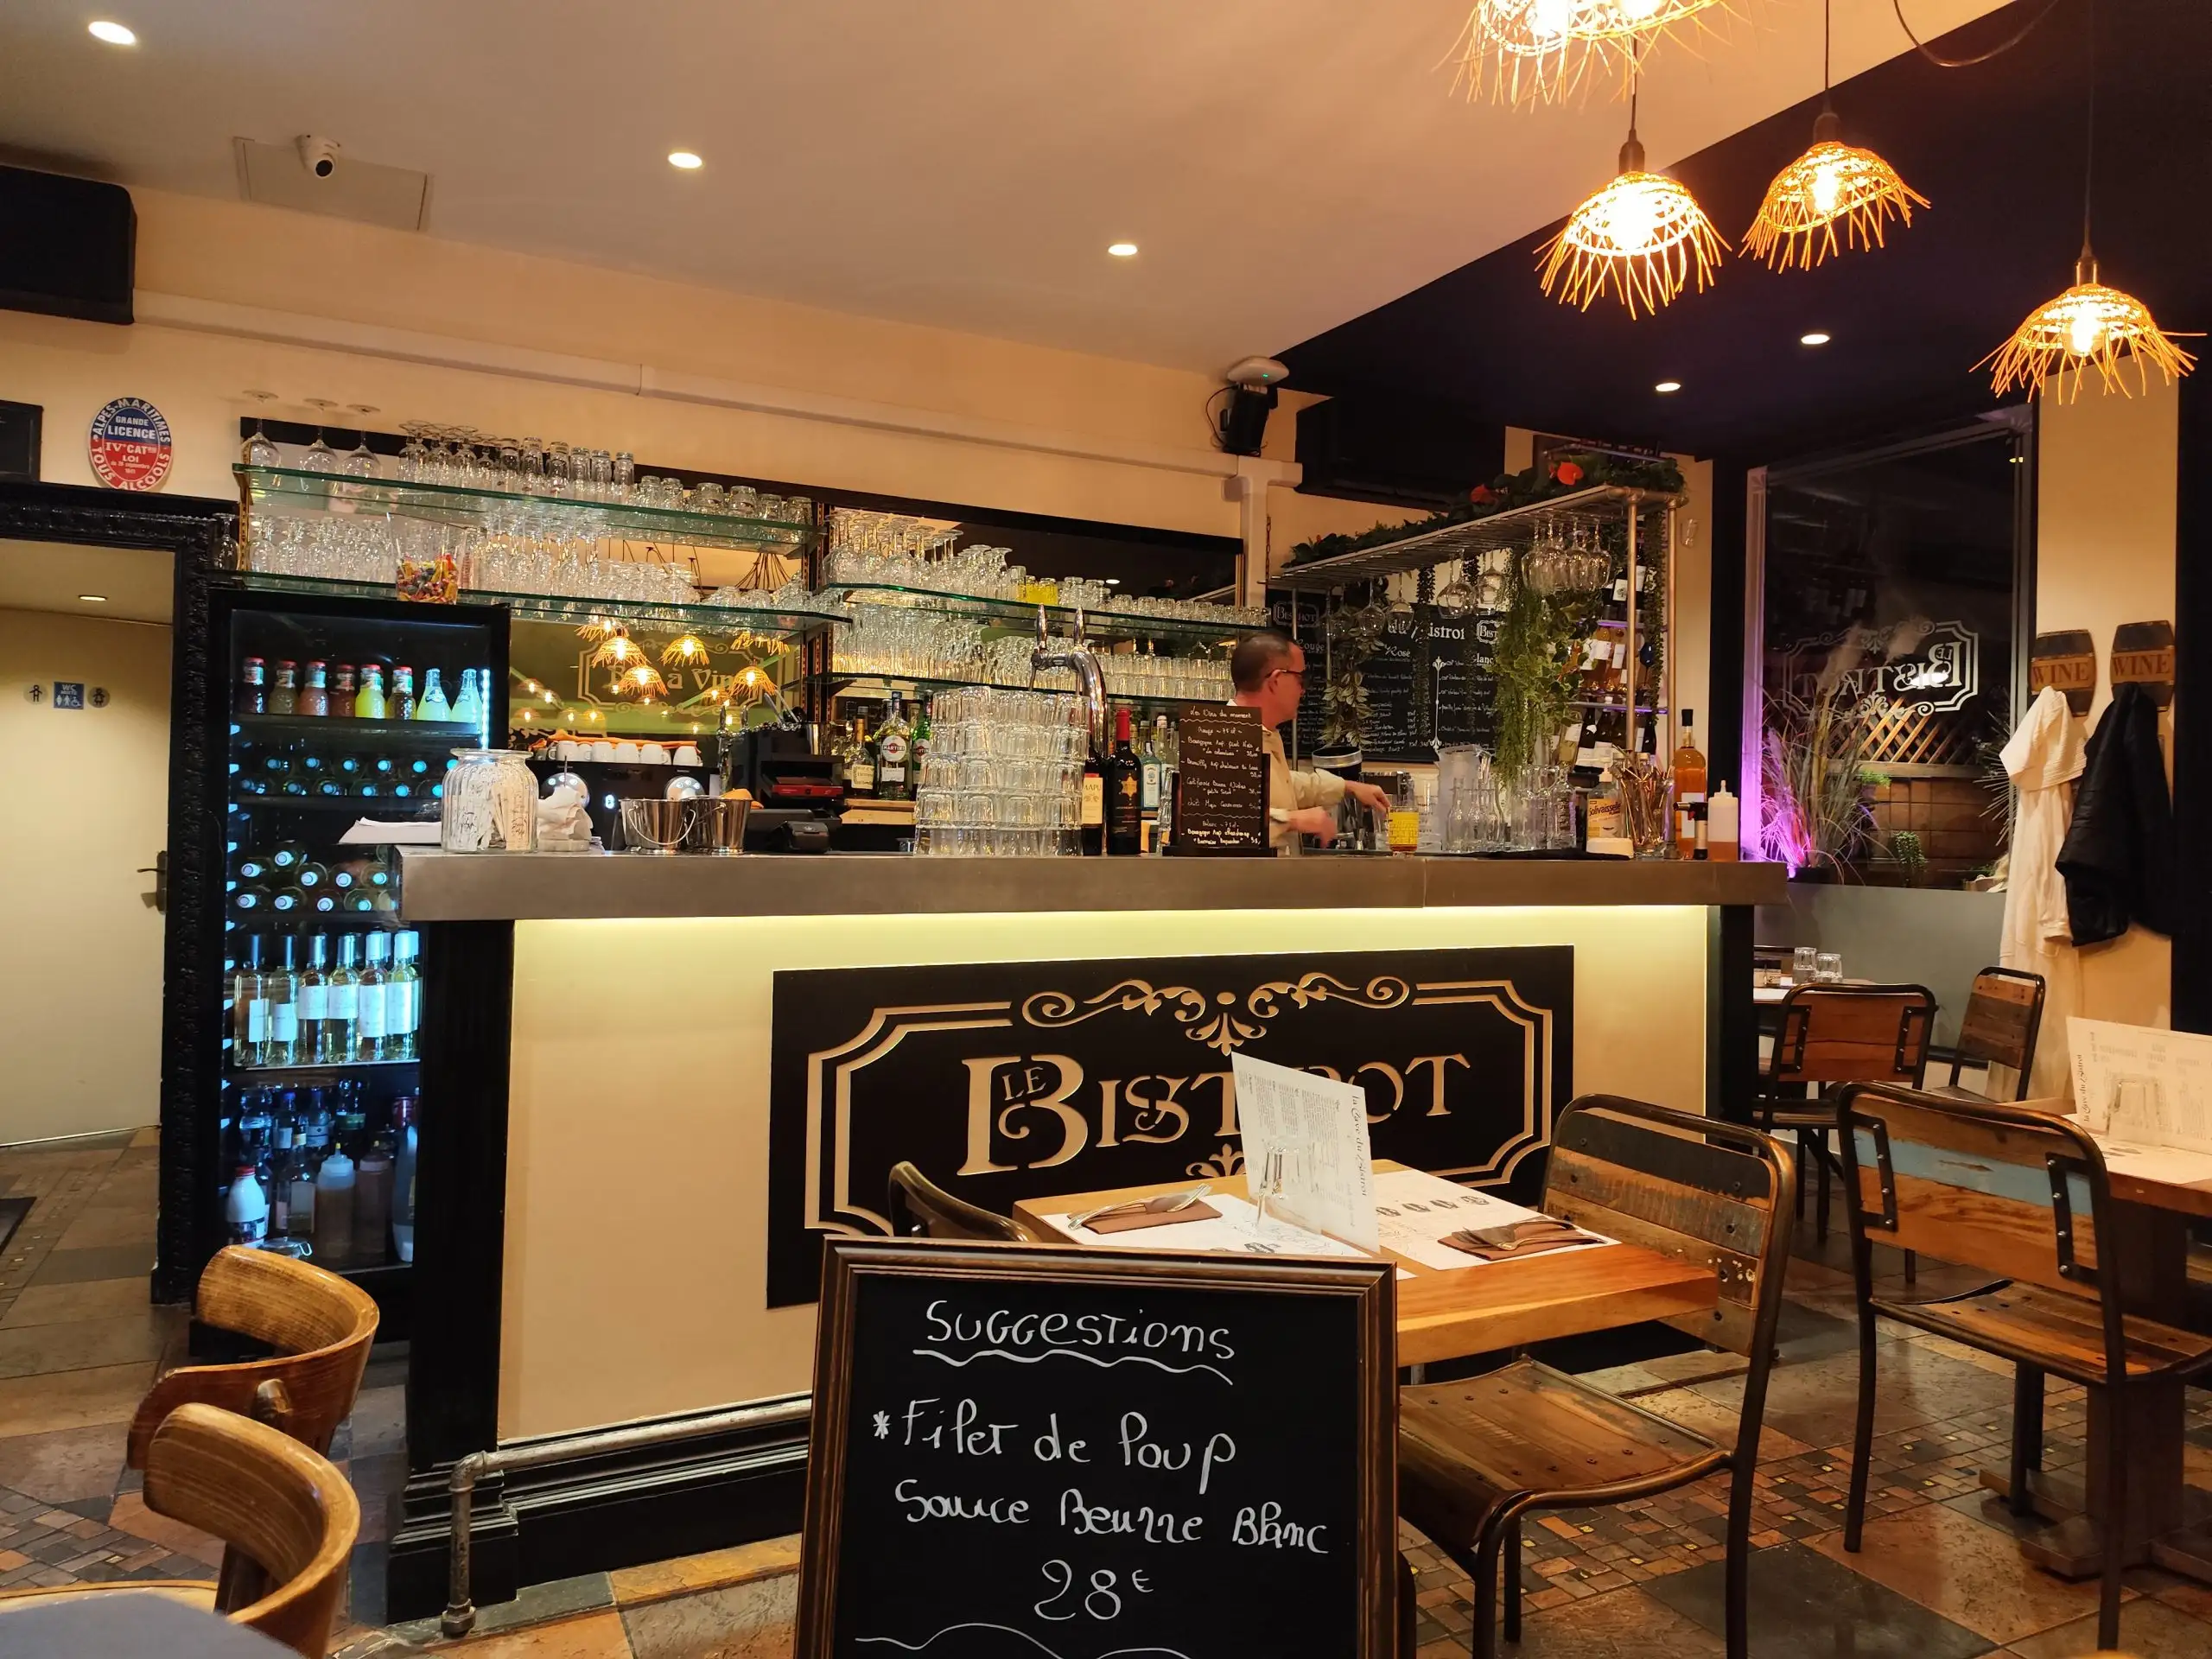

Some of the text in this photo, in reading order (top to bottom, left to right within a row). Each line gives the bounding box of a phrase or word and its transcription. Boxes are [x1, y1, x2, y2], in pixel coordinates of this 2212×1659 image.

[92, 398, 171, 443] ALPES-MARITIMES
[107, 425, 156, 440] LICENCE
[115, 416, 149, 427] GRANDE
[91, 446, 170, 491] TOUS ALCOOLS
[122, 454, 139, 464] LOI
[1472, 652, 1494, 665] lanc
[2112, 653, 2171, 677] WINE
[2032, 662, 2090, 684] WINE
[1004, 1067, 1046, 1100] LE
[957, 1052, 1471, 1176] BISTOT
[1034, 1413, 1091, 1464] de
[1060, 1488, 1203, 1543] Beurre
[1232, 1501, 1329, 1554] Blanc
